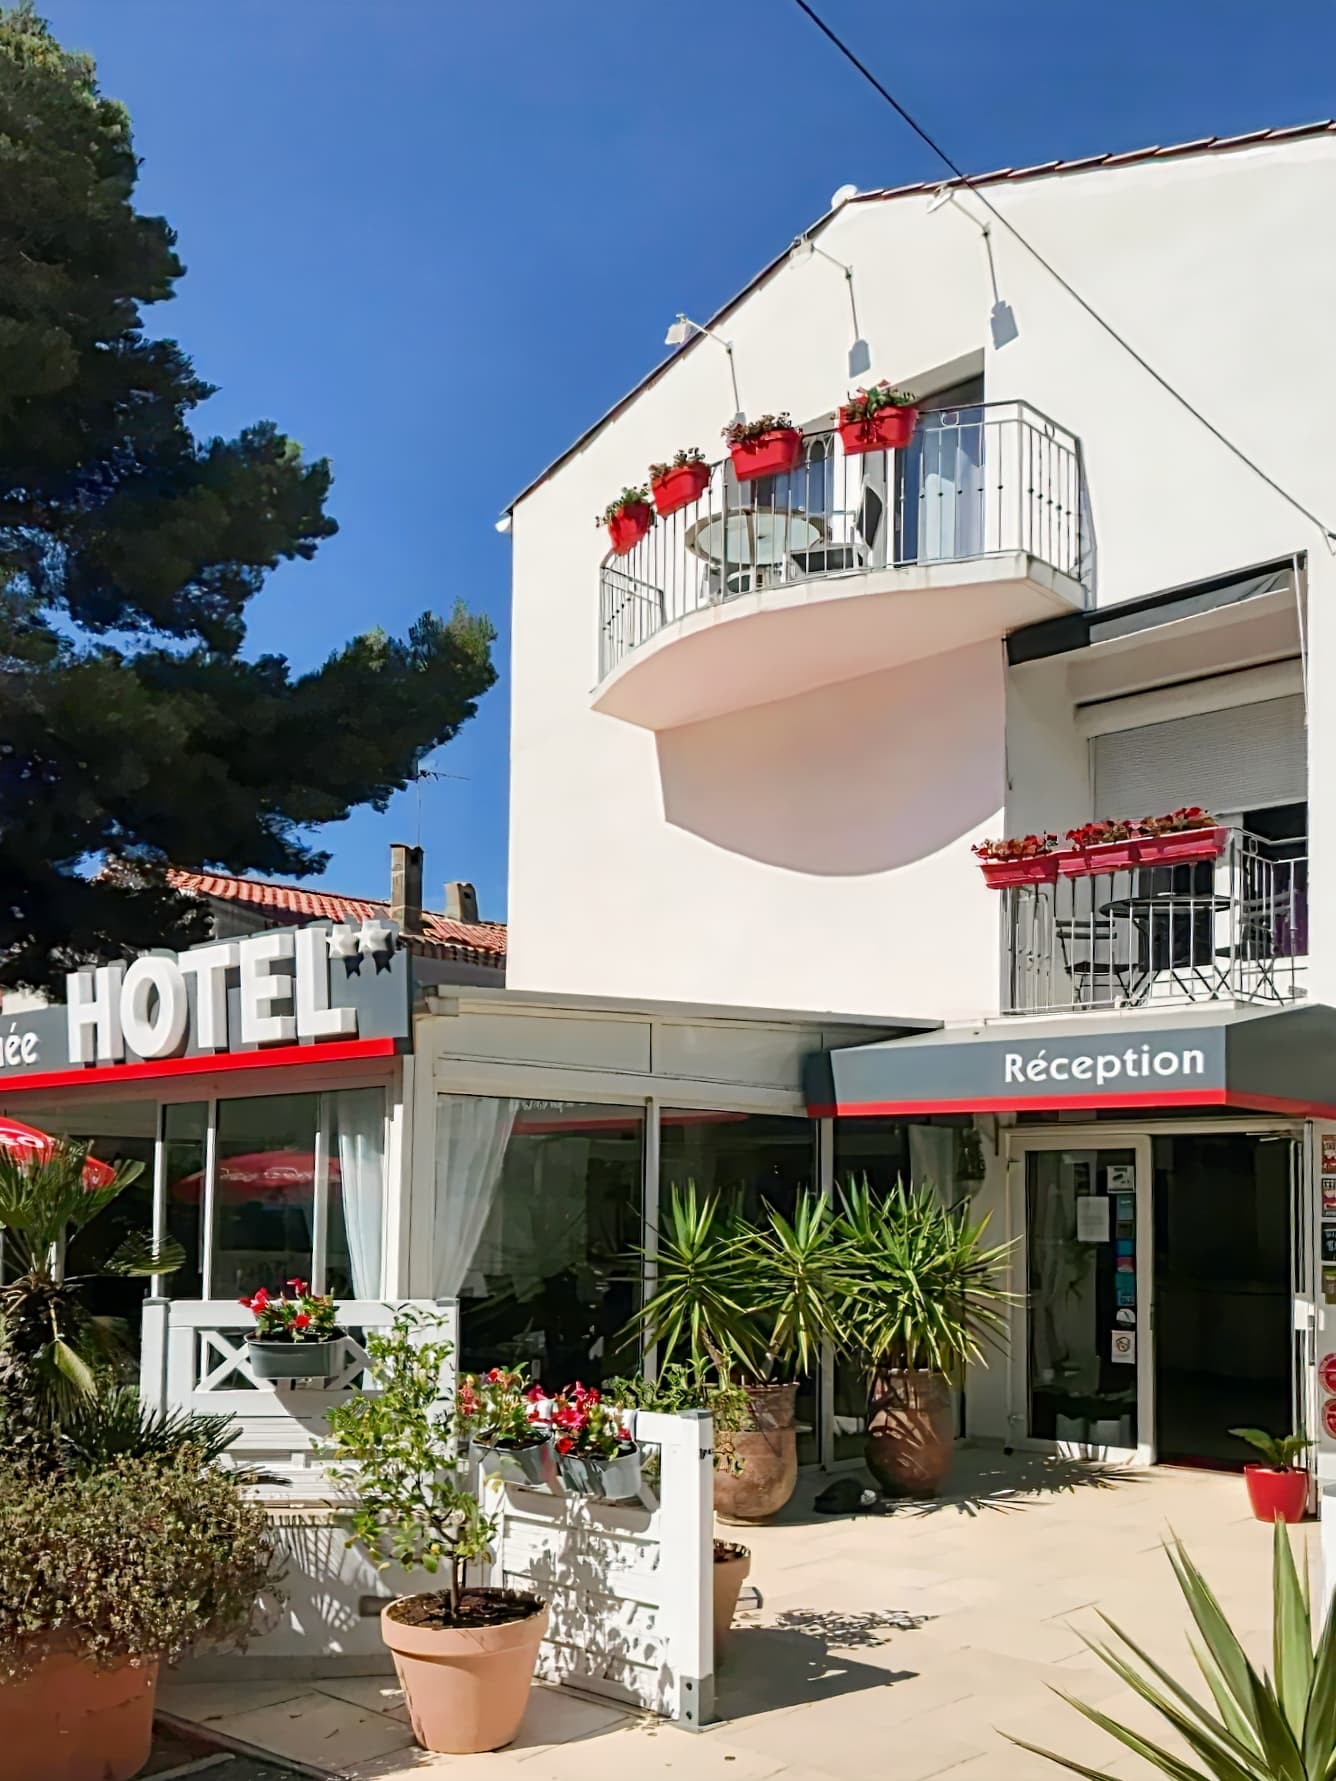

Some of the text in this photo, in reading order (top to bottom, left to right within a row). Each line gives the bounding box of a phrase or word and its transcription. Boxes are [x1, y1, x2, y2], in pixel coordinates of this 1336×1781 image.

[66, 927, 357, 1063] HOTEL
[0, 1021, 40, 1067] ée
[1004, 1044, 1205, 1085] Réception
